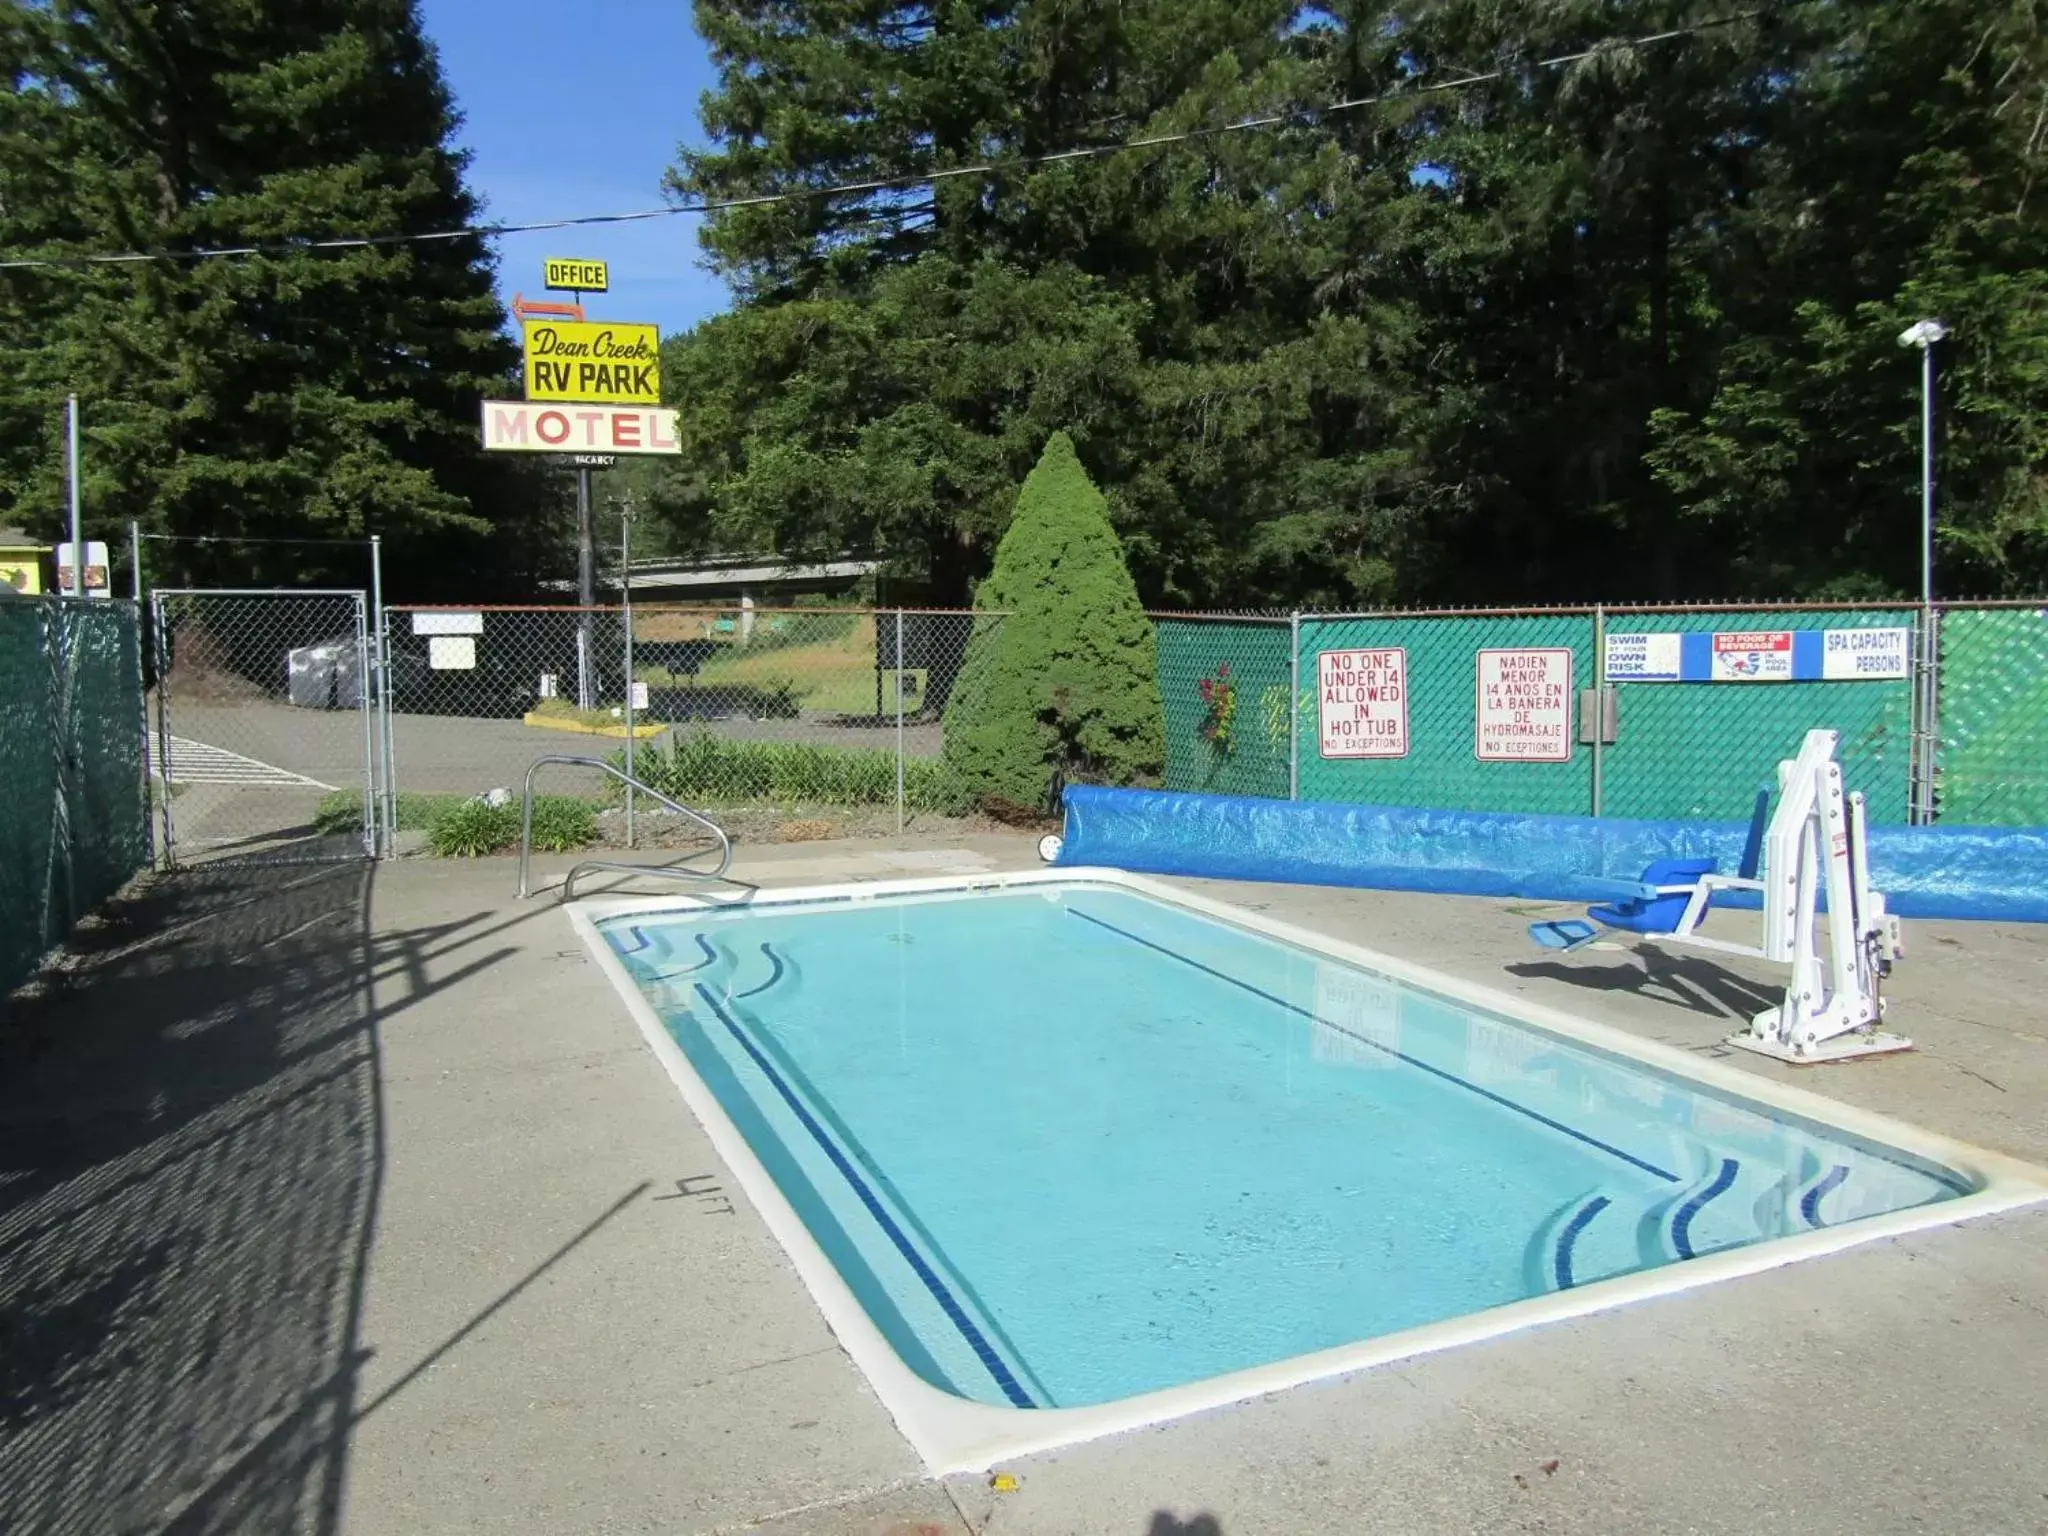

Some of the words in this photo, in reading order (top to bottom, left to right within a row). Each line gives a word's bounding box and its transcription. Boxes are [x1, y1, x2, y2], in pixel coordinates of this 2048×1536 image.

[550, 264, 604, 285] OFFICE
[532, 328, 589, 357] Dean
[593, 331, 648, 360] Creek
[534, 361, 571, 392] RV
[579, 363, 654, 395] PARK
[494, 409, 676, 448] MOTEL
[1608, 636, 1647, 645] SWIM
[1719, 635, 1735, 643] NO
[1737, 635, 1766, 643] FOOD
[1768, 634, 1784, 642] OR
[1828, 634, 1848, 651] SPA
[1851, 632, 1901, 650] CAPACITY
[1719, 643, 1774, 651] BEVERAGE
[1331, 655, 1352, 670] NO
[1361, 653, 1393, 670] ONE
[1500, 656, 1547, 669] NADIEN
[1608, 653, 1646, 662] OWN
[1856, 655, 1901, 672] PERSONS
[1608, 663, 1645, 671] RISK
[1325, 671, 1376, 687] UNDER
[1384, 670, 1399, 685] 14
[1501, 670, 1545, 682] MENOR
[1326, 686, 1399, 703] ALLOWED
[1487, 683, 1499, 696] 14
[1546, 683, 1562, 696] EN
[1488, 698, 1503, 710] LA
[1354, 704, 1369, 719] IN
[1514, 711, 1531, 723] DE
[1331, 720, 1361, 735] HOT
[1367, 719, 1396, 735] TUB
[1484, 724, 1561, 737] HYDROMASAJE
[1325, 739, 1337, 749] NO
[1345, 738, 1402, 749] EXCEPTIONS
[1486, 742, 1500, 752] NO
[1506, 742, 1559, 753] ECEPTIONES
